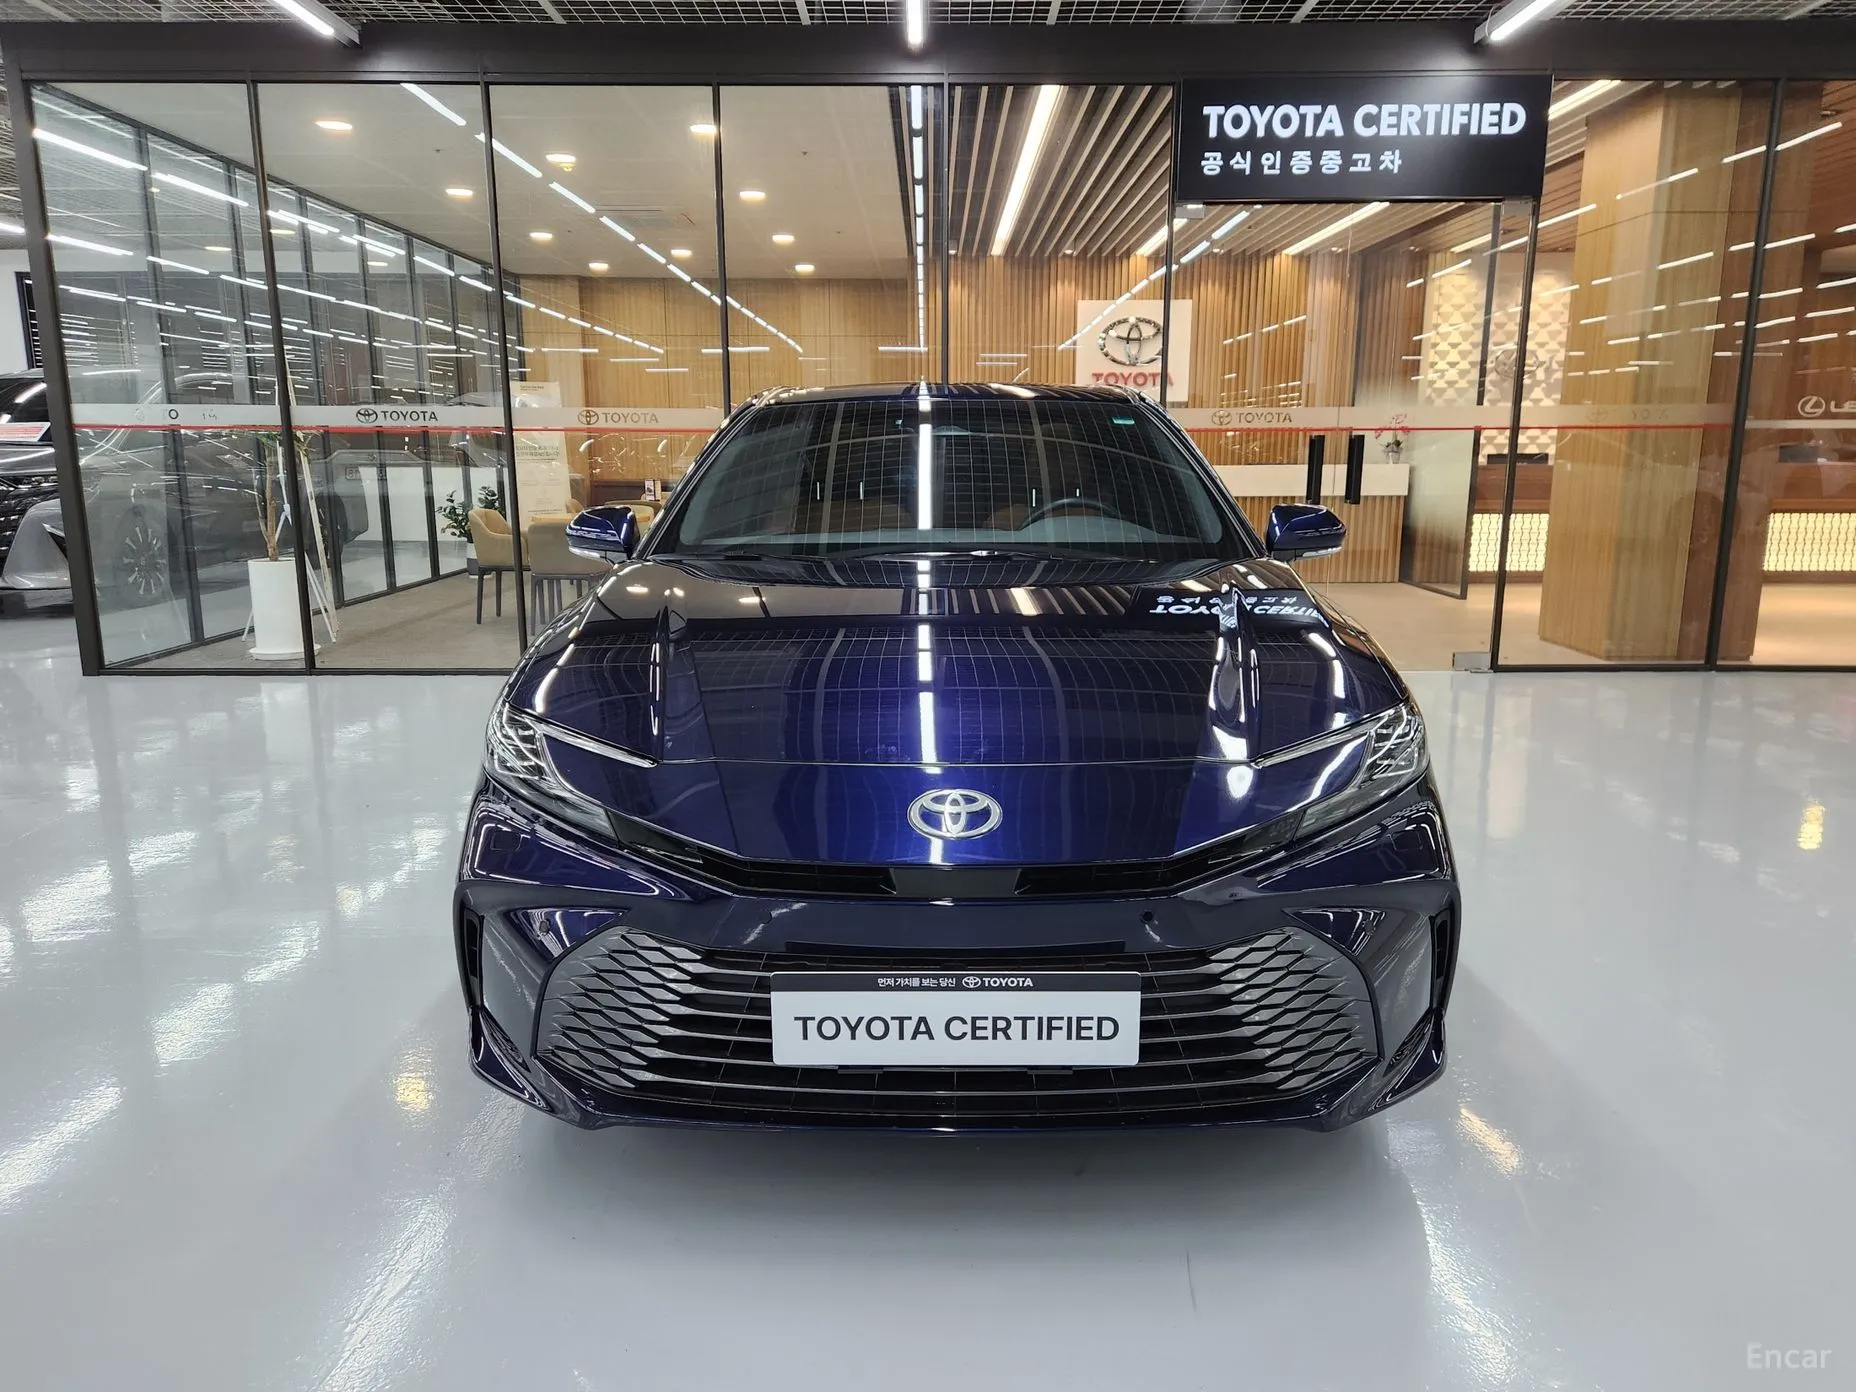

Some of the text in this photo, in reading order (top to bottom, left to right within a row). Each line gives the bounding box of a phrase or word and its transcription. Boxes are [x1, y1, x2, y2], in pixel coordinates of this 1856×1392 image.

[1202, 103, 1526, 138] TOYOTA CERTIFIED
[380, 410, 438, 422] TOYOTA
[602, 412, 659, 424] TOYOTA
[1236, 412, 1292, 424] TOYOTA
[877, 977, 956, 988] 먼저 가치를 보는 당신
[983, 977, 1033, 987] TOYOTA
[794, 1015, 1120, 1041] TOYOTA CERTIFIED
